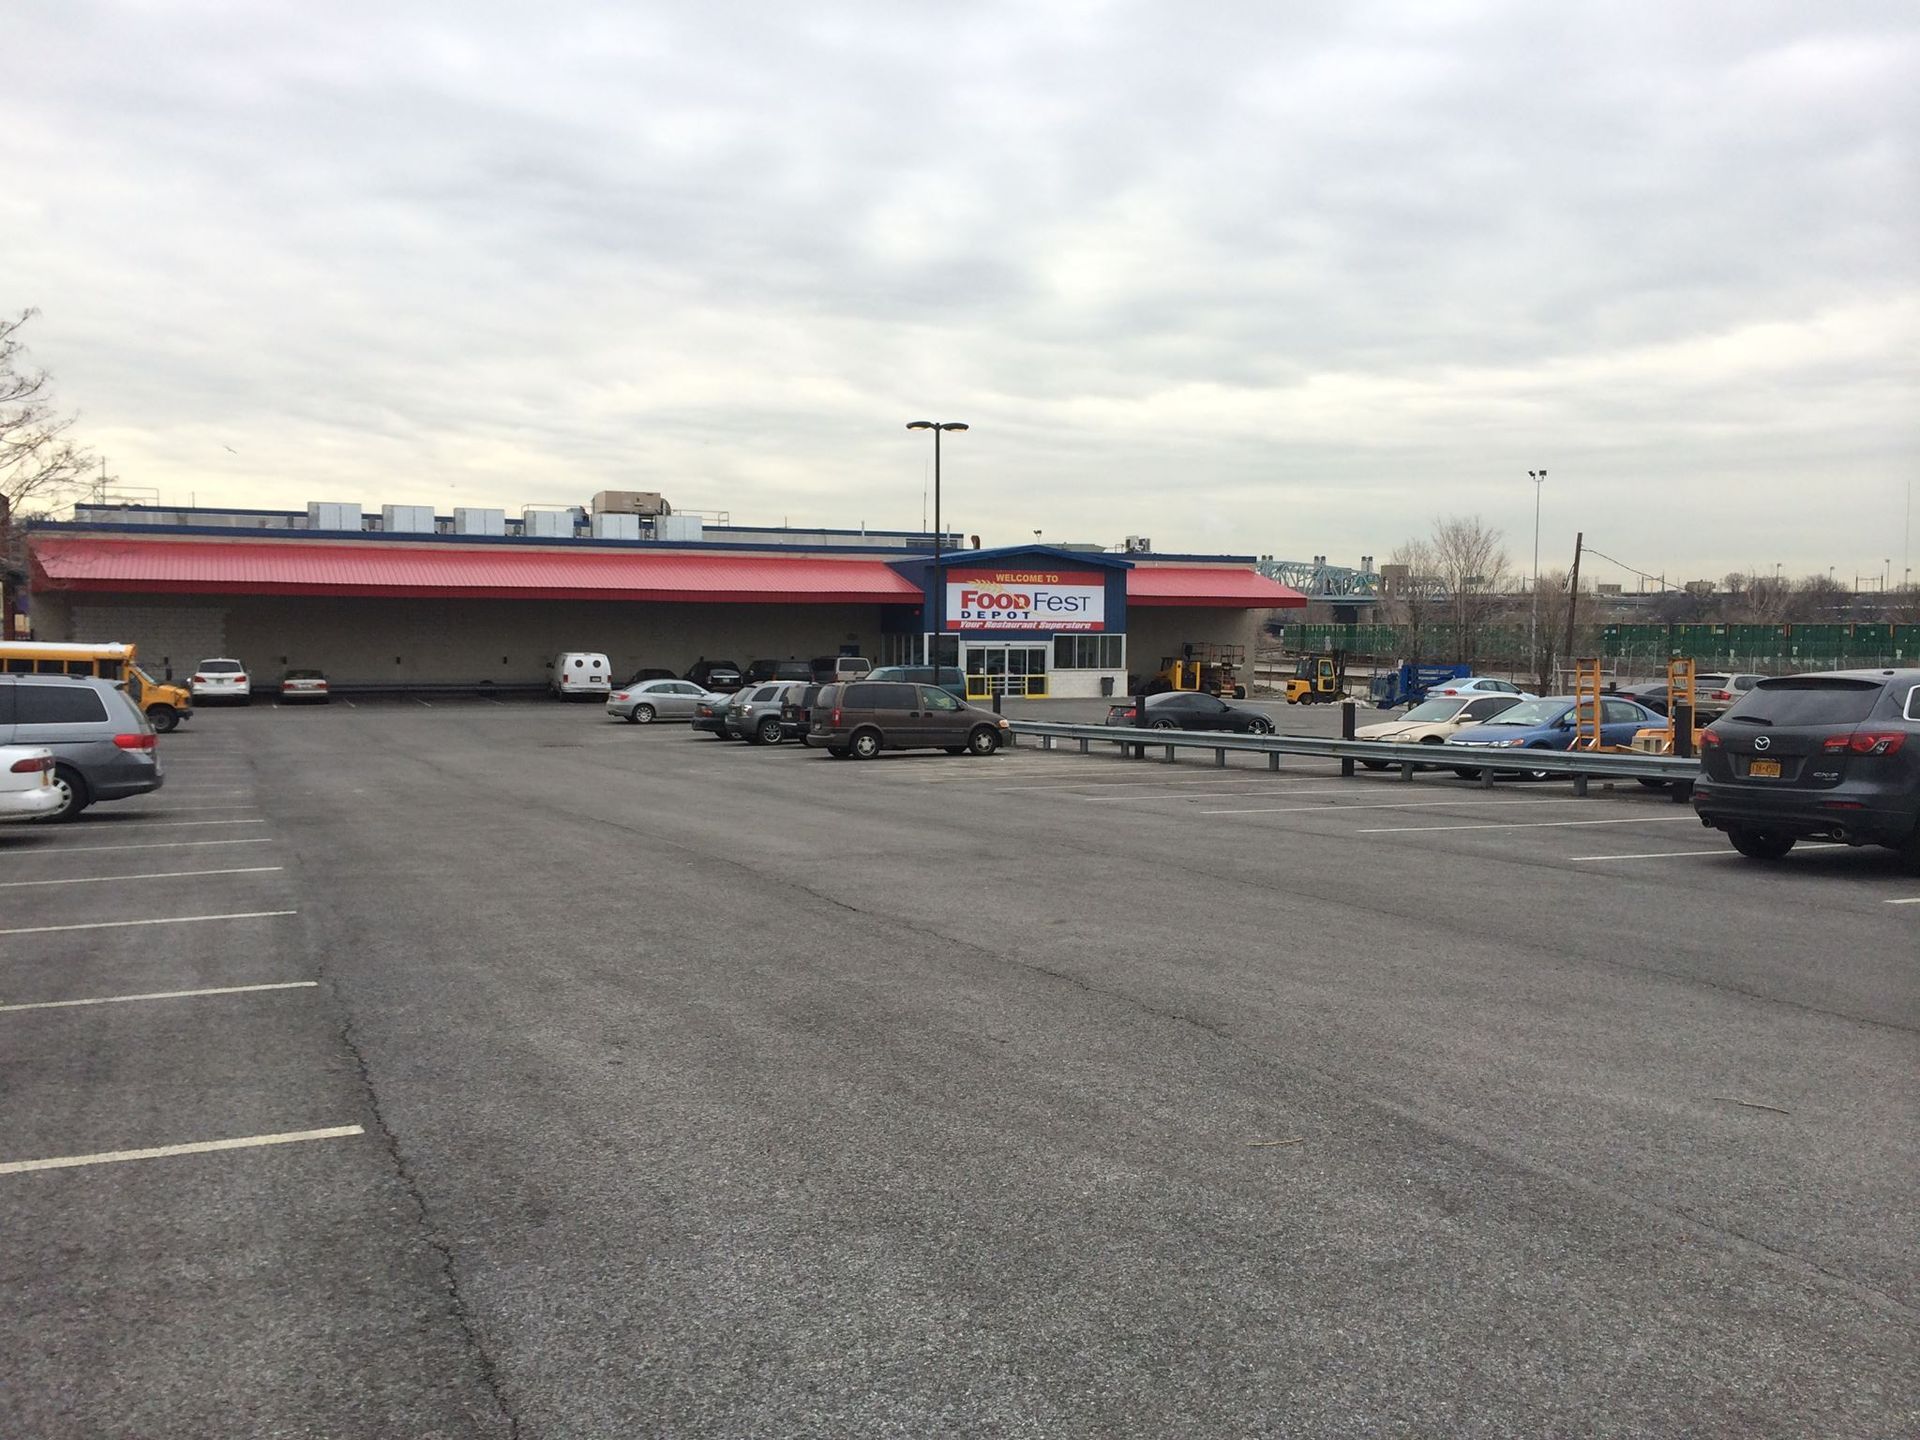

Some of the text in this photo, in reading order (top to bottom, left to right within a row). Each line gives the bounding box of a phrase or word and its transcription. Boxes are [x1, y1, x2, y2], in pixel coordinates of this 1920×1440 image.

[996, 573, 1059, 583] WELCOME TO
[961, 590, 1031, 610] FOOD
[961, 610, 1030, 620] DEPOT
[960, 621, 1091, 630] Your Restaurant Superstore
